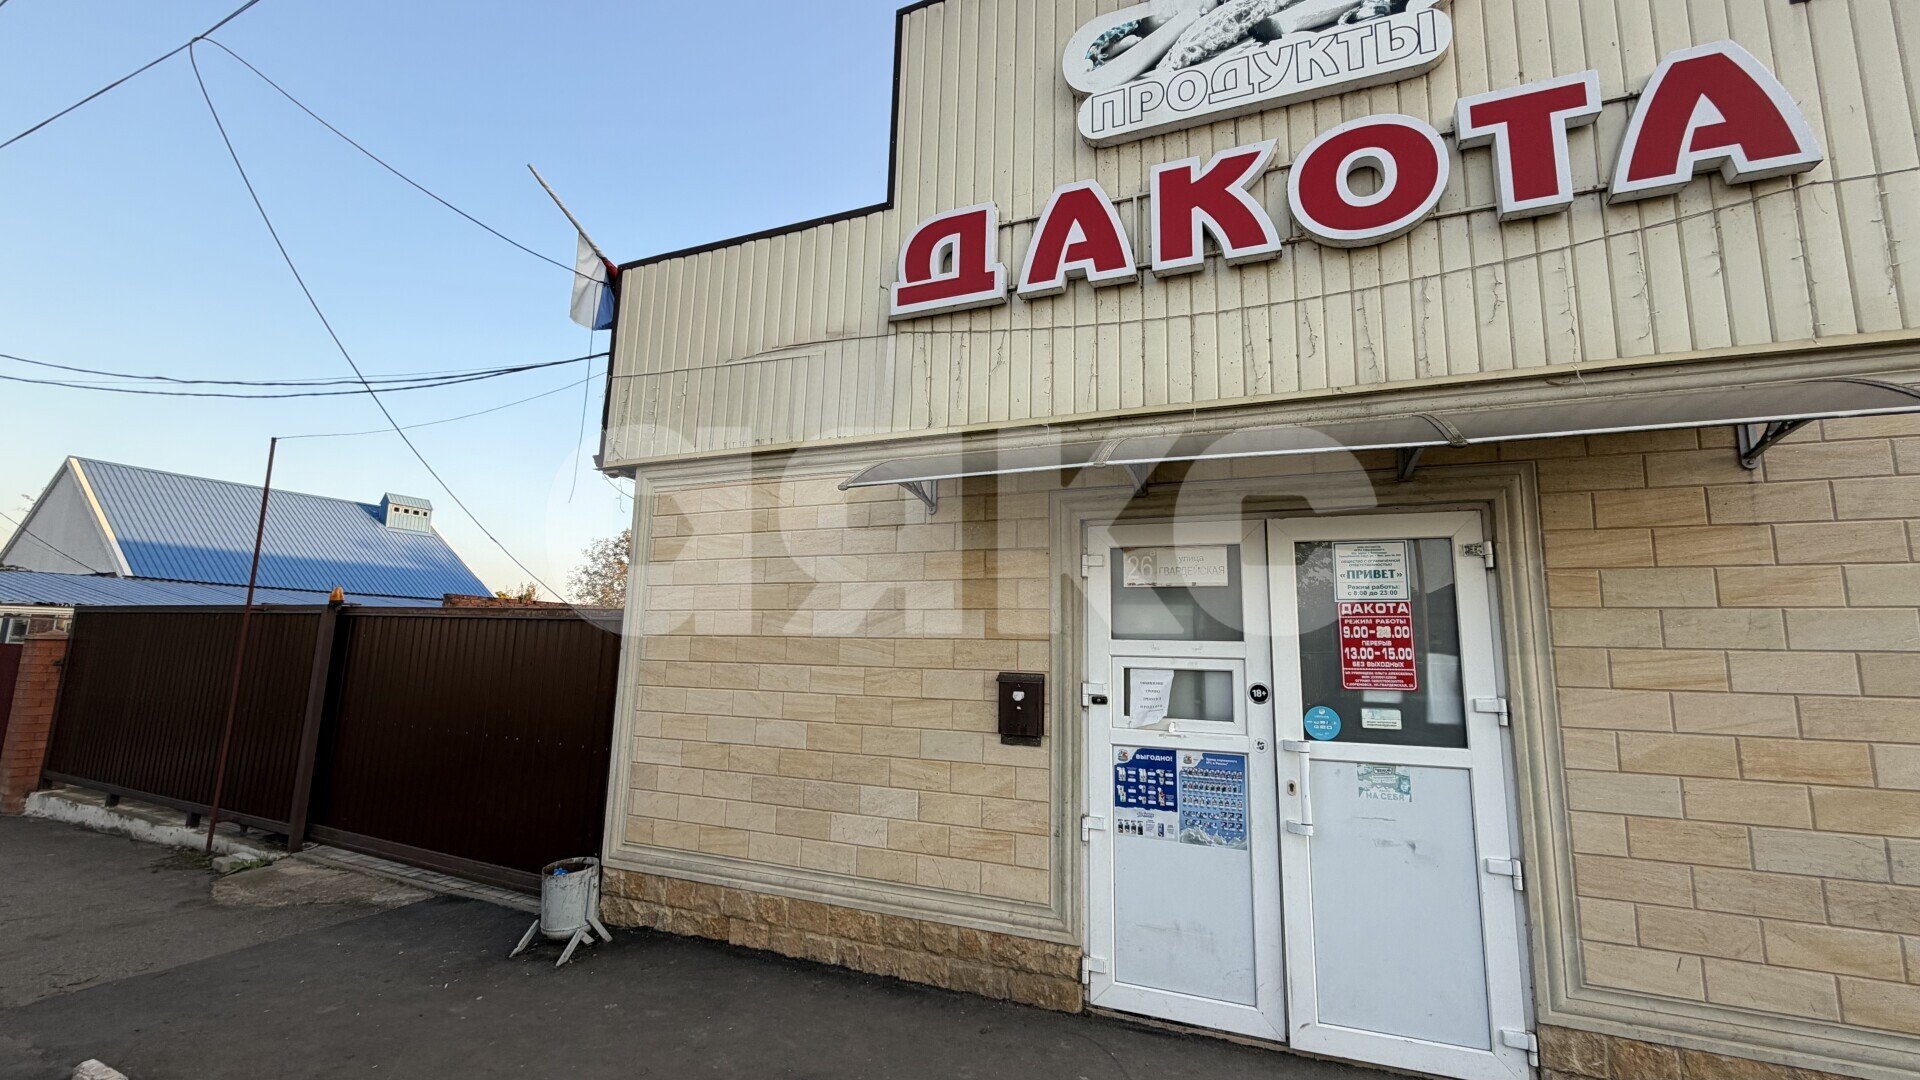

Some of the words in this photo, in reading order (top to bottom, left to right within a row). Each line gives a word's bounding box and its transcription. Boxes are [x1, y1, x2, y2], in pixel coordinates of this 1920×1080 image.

[1091, 9, 1436, 133] ПРОДУКТЫ
[891, 42, 1812, 316] ДАКОТА
[1178, 556, 1204, 564] улица
[1158, 565, 1225, 576] ГВАРДЕЙСКАЯ
[1340, 570, 1403, 579] «ПРИВЕТ»
[1342, 602, 1408, 614] ДАКОТА
[1252, 689, 1267, 698] 18+
[1136, 754, 1173, 762] ВЫГОДНО!
